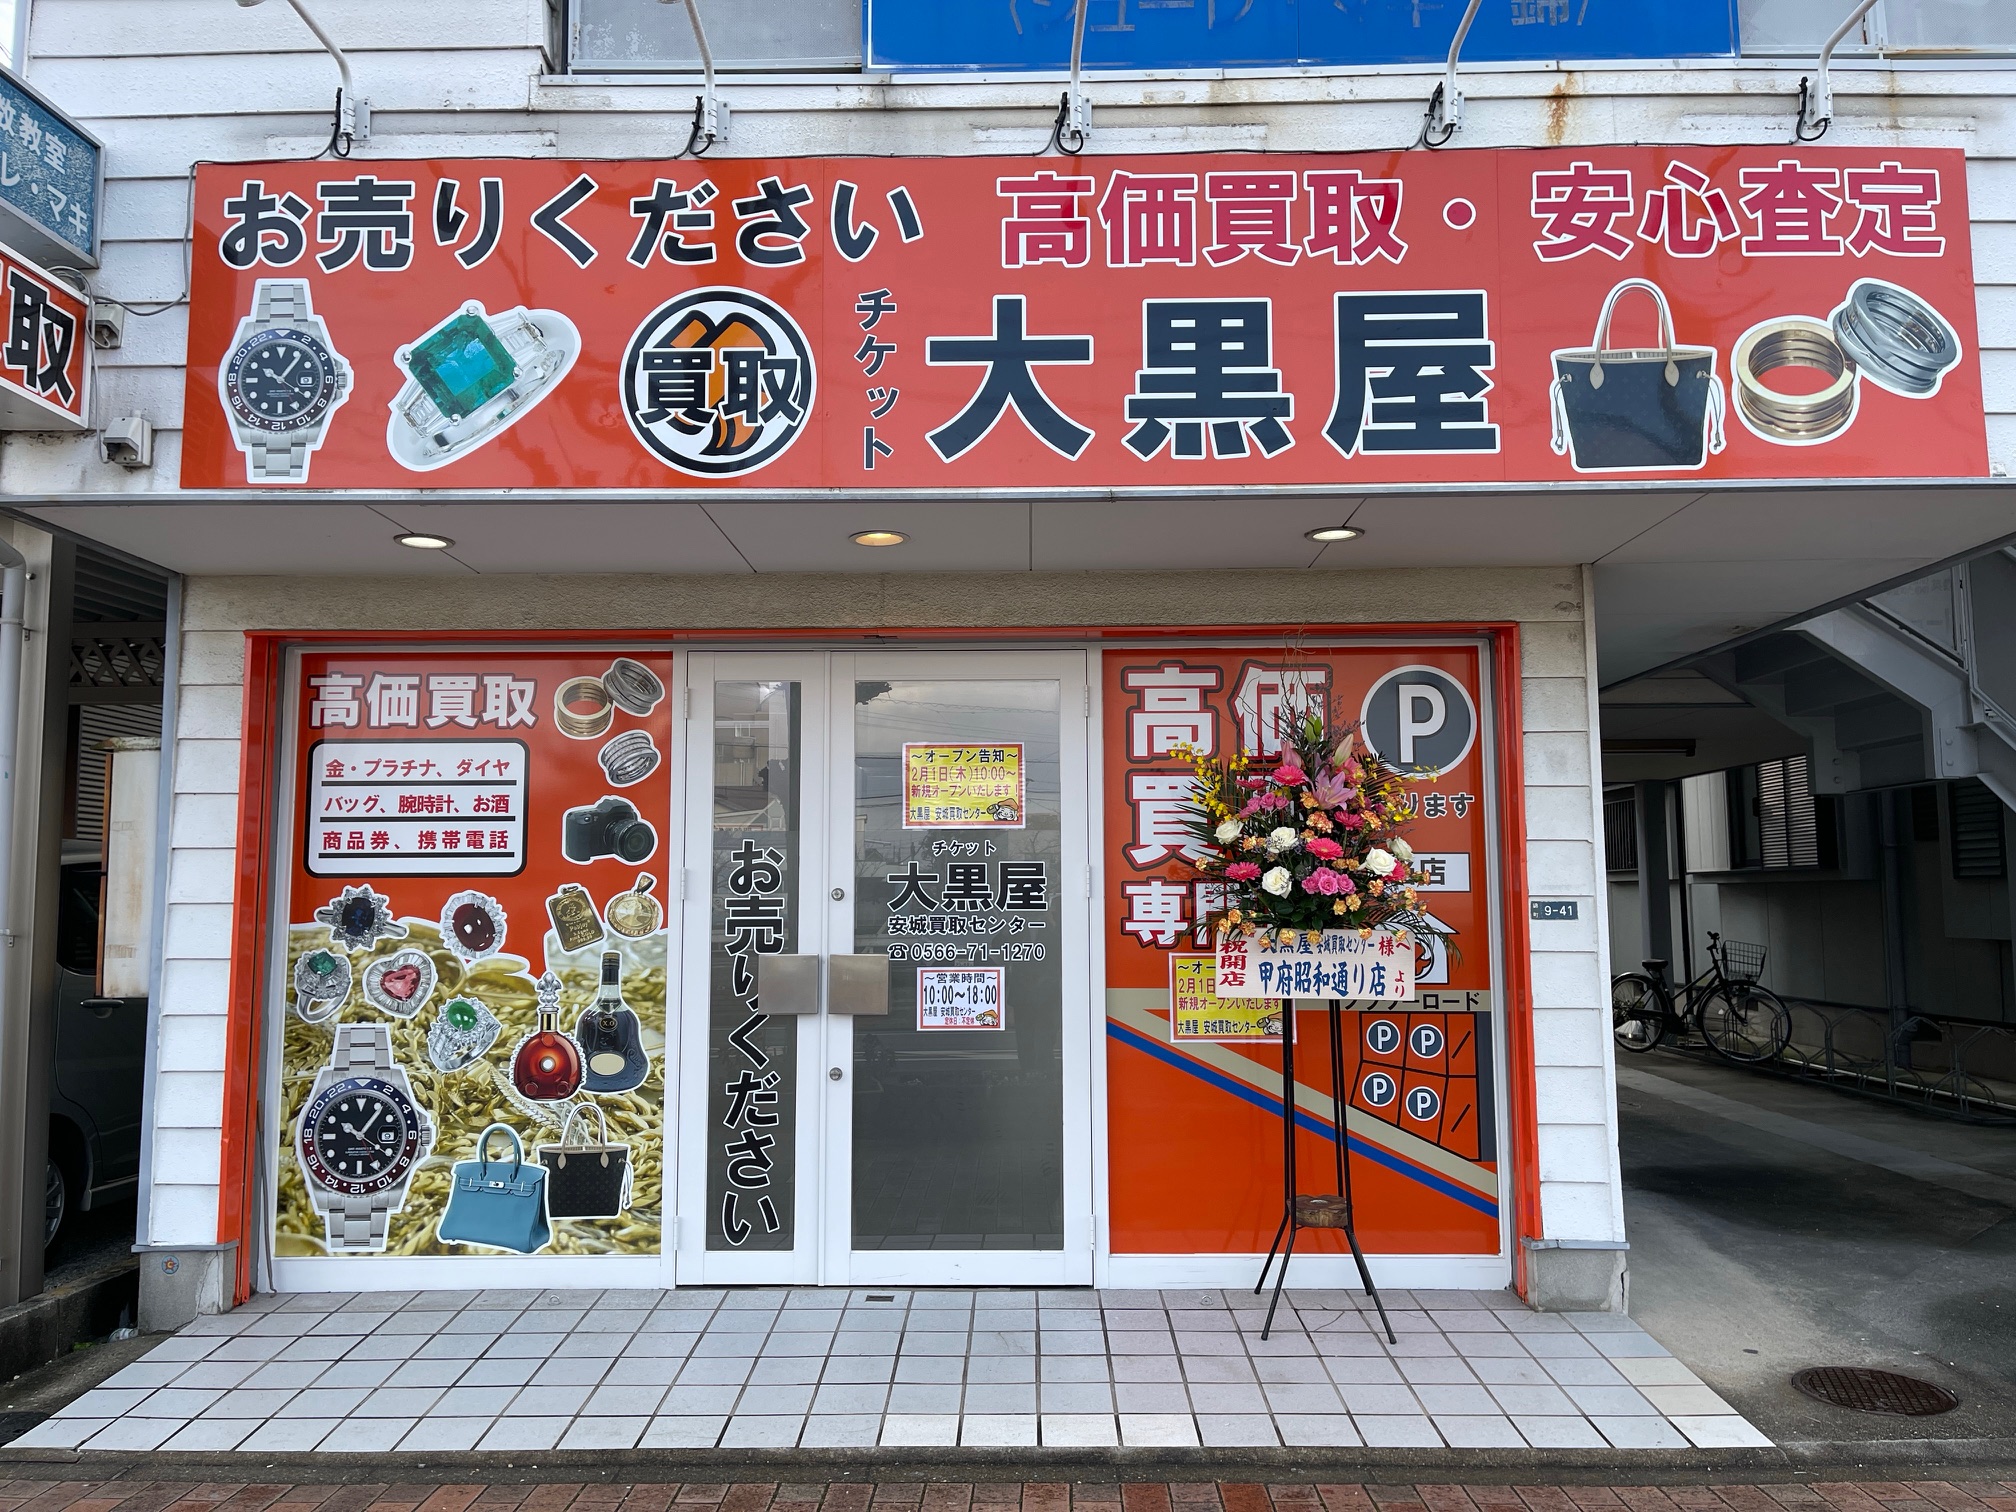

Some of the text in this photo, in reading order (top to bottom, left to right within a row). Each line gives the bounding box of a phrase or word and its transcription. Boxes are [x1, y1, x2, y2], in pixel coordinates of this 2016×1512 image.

[219, 173, 923, 273] お売りください
[996, 160, 1946, 269] 高価買取・安心査定
[228, 333, 334, 430] 2 4 6 8 10 12 14 16 18 20 22
[636, 347, 804, 428] 買取
[854, 288, 899, 470] チケット
[925, 290, 1501, 463] 大黒屋
[309, 672, 538, 729] 高価買取
[1125, 663, 1328, 760] 高価
[1398, 684, 1446, 763] P
[910, 806, 987, 821] 大黒屋 安城買取センター
[322, 830, 509, 850] 商品券、携帯電話
[932, 839, 997, 857] チケット
[887, 860, 1048, 912] 大黒屋
[887, 914, 1046, 936] 安城買取センター
[1544, 905, 1573, 916] 9-41
[911, 943, 1046, 961] 0566-71-1270
[1218, 939, 1249, 987] 祝開店
[1258, 960, 1387, 998] 甲府昭和通り店
[1394, 970, 1405, 998] より
[923, 1006, 938, 1017] 大黒屋
[1178, 1020, 1257, 1034] 大黒屋 安城買取センター
[1378, 1026, 1392, 1050] P
[1420, 1030, 1436, 1053] P
[1373, 1078, 1388, 1102] P
[1416, 1092, 1432, 1116] P
[304, 1084, 416, 1194] 2 4 6 8 10 12 14 16 18 20 22
